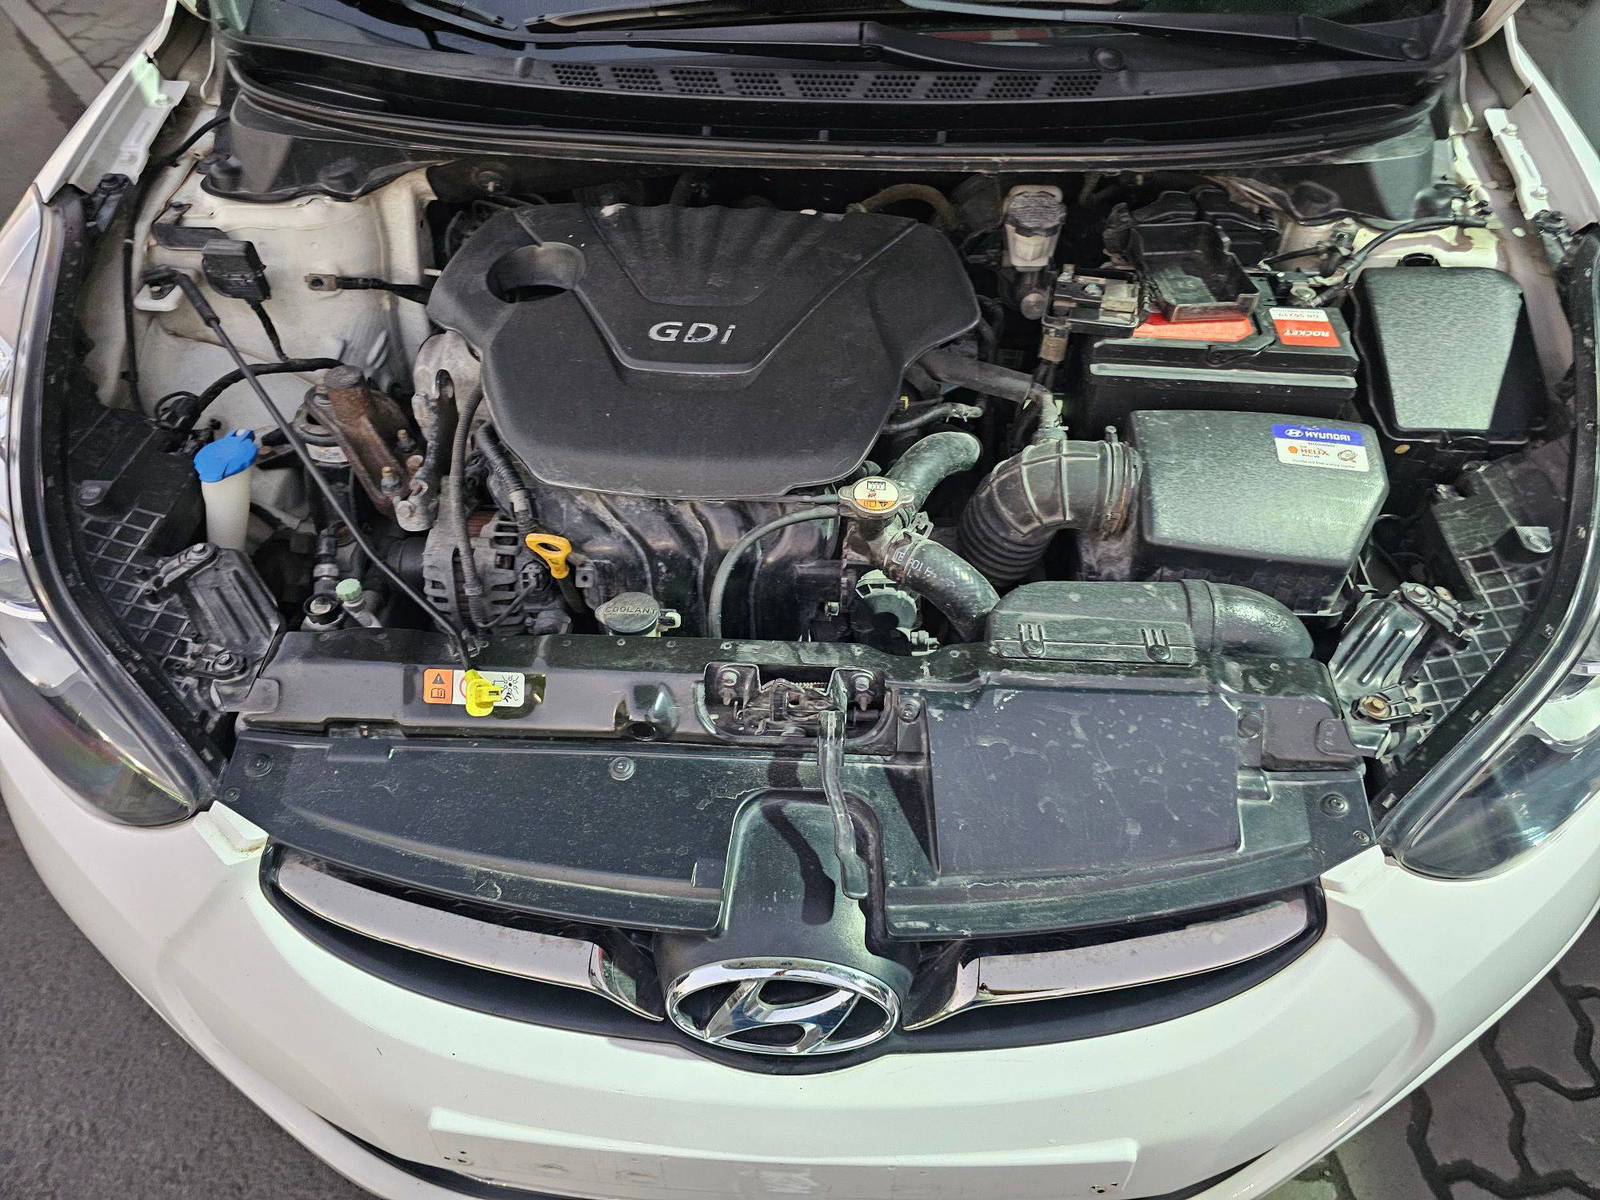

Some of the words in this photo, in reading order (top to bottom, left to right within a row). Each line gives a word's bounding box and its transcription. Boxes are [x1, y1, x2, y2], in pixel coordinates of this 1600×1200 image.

[648, 321, 736, 344] GDi
[1283, 328, 1330, 337] ROCKET
[1304, 430, 1351, 441] HYUNDAI
[605, 606, 657, 615] COOLANT
